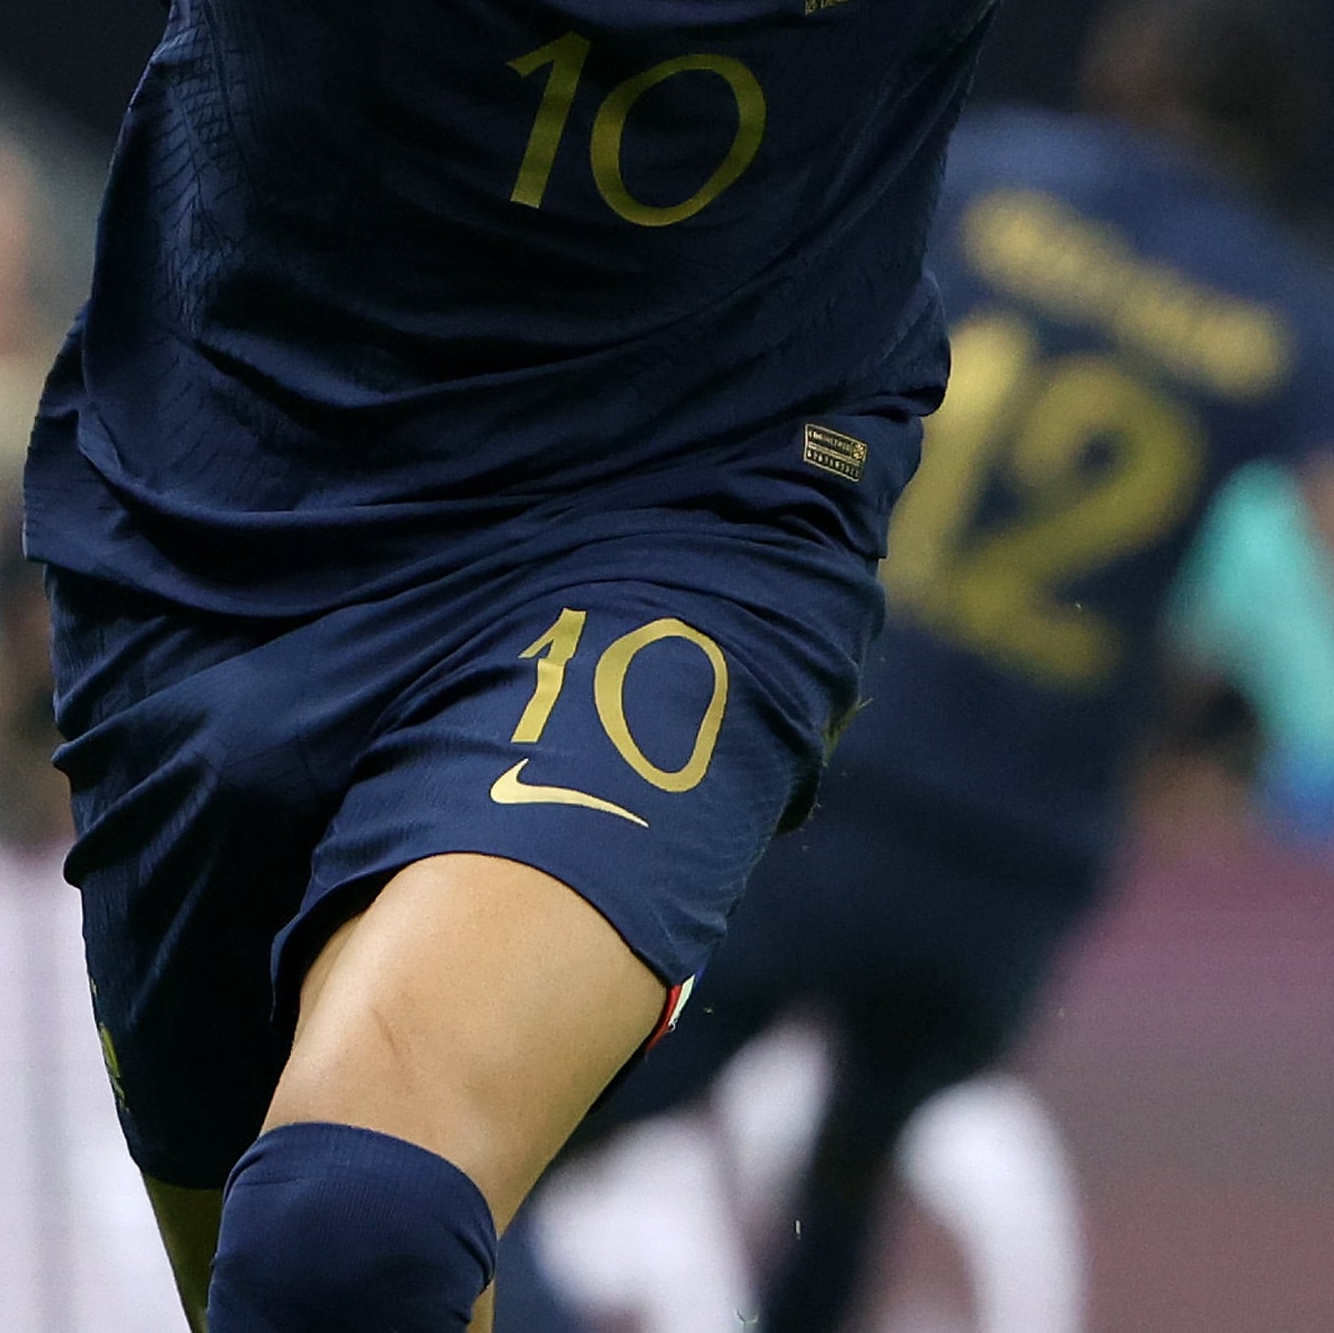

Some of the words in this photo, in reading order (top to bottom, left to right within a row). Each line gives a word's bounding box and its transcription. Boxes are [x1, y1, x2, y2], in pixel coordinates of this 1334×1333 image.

[506, 30, 767, 228] 10
[879, 315, 1205, 689] 12
[510, 607, 730, 793] 10
